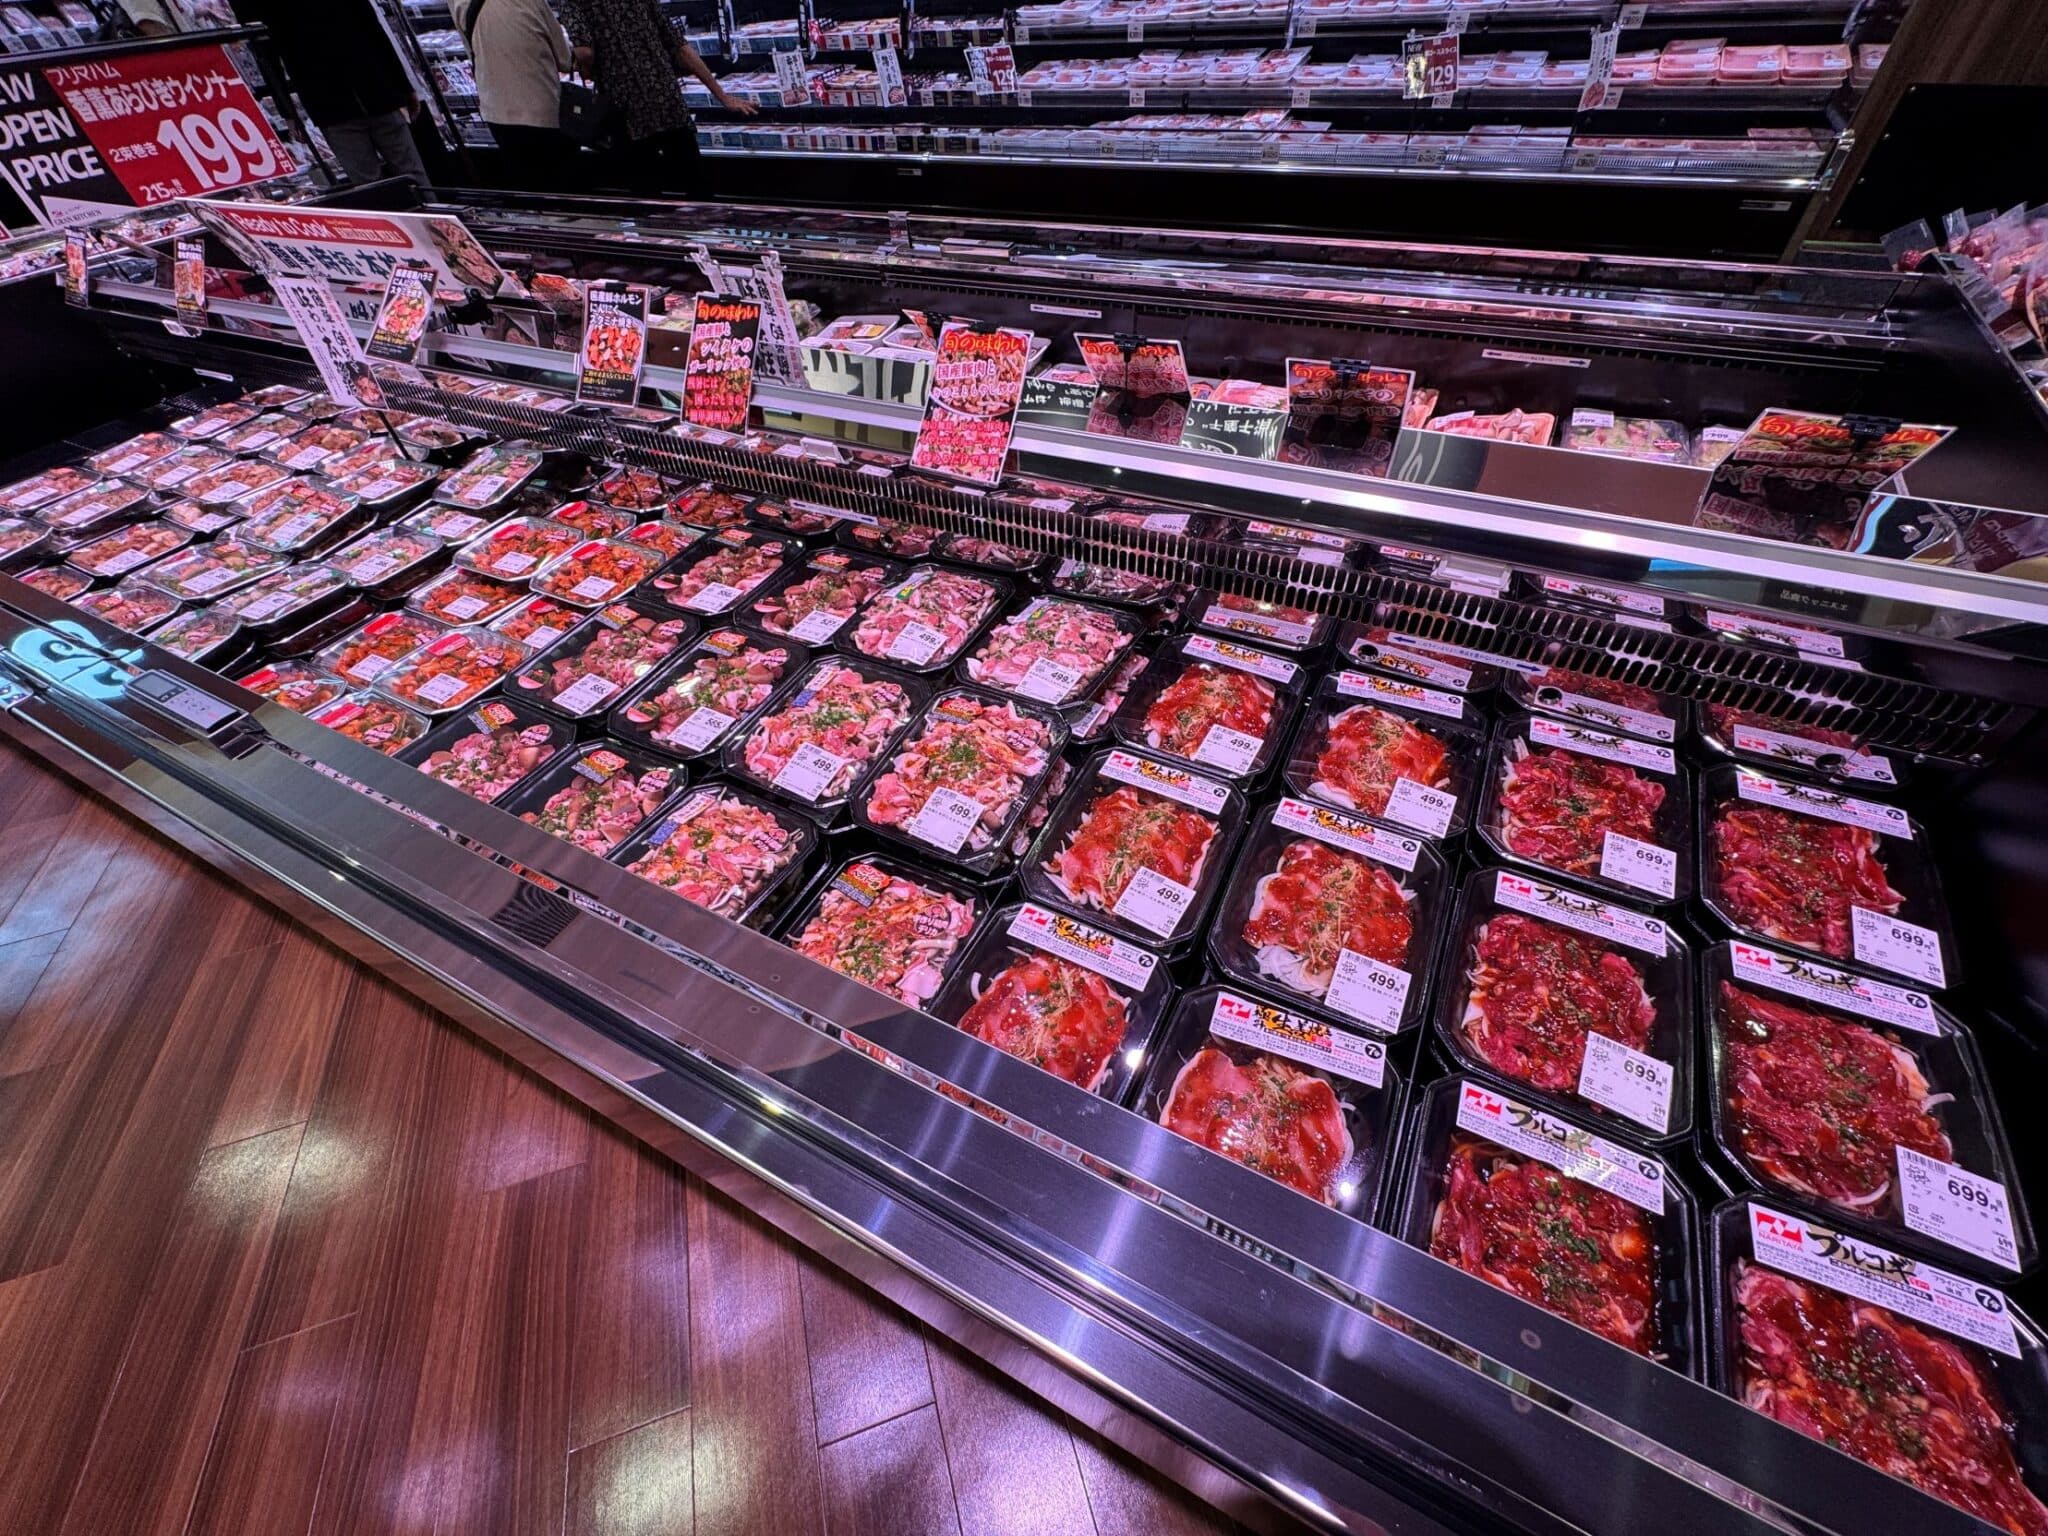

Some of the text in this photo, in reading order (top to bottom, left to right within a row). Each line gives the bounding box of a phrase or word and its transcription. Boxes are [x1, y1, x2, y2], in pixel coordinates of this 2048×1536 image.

[1428, 64, 1454, 86] 129
[0, 72, 36, 104] W
[157, 107, 276, 188] 199
[12, 146, 104, 190] PRICE
[229, 212, 282, 236] Ready
[288, 218, 336, 239] Cook
[697, 299, 759, 322] 旬の味わい
[944, 328, 1028, 352] 旬の味わい
[1082, 340, 1177, 357] 旬のわい
[936, 358, 996, 380] 国産豚肉と
[1294, 364, 1408, 384] 旬のわい
[812, 758, 832, 771] 499
[949, 804, 970, 818] 499
[1420, 794, 1444, 808] 499
[1636, 849, 1663, 865] 699
[1157, 886, 1180, 904] 499
[1534, 886, 1608, 916] プルコギ
[1774, 957, 1861, 990] プルコギ
[1506, 1102, 1594, 1152] プルコギ
[1758, 1232, 1802, 1251] NARITAYA
[1806, 1230, 1918, 1284] プルコギ
